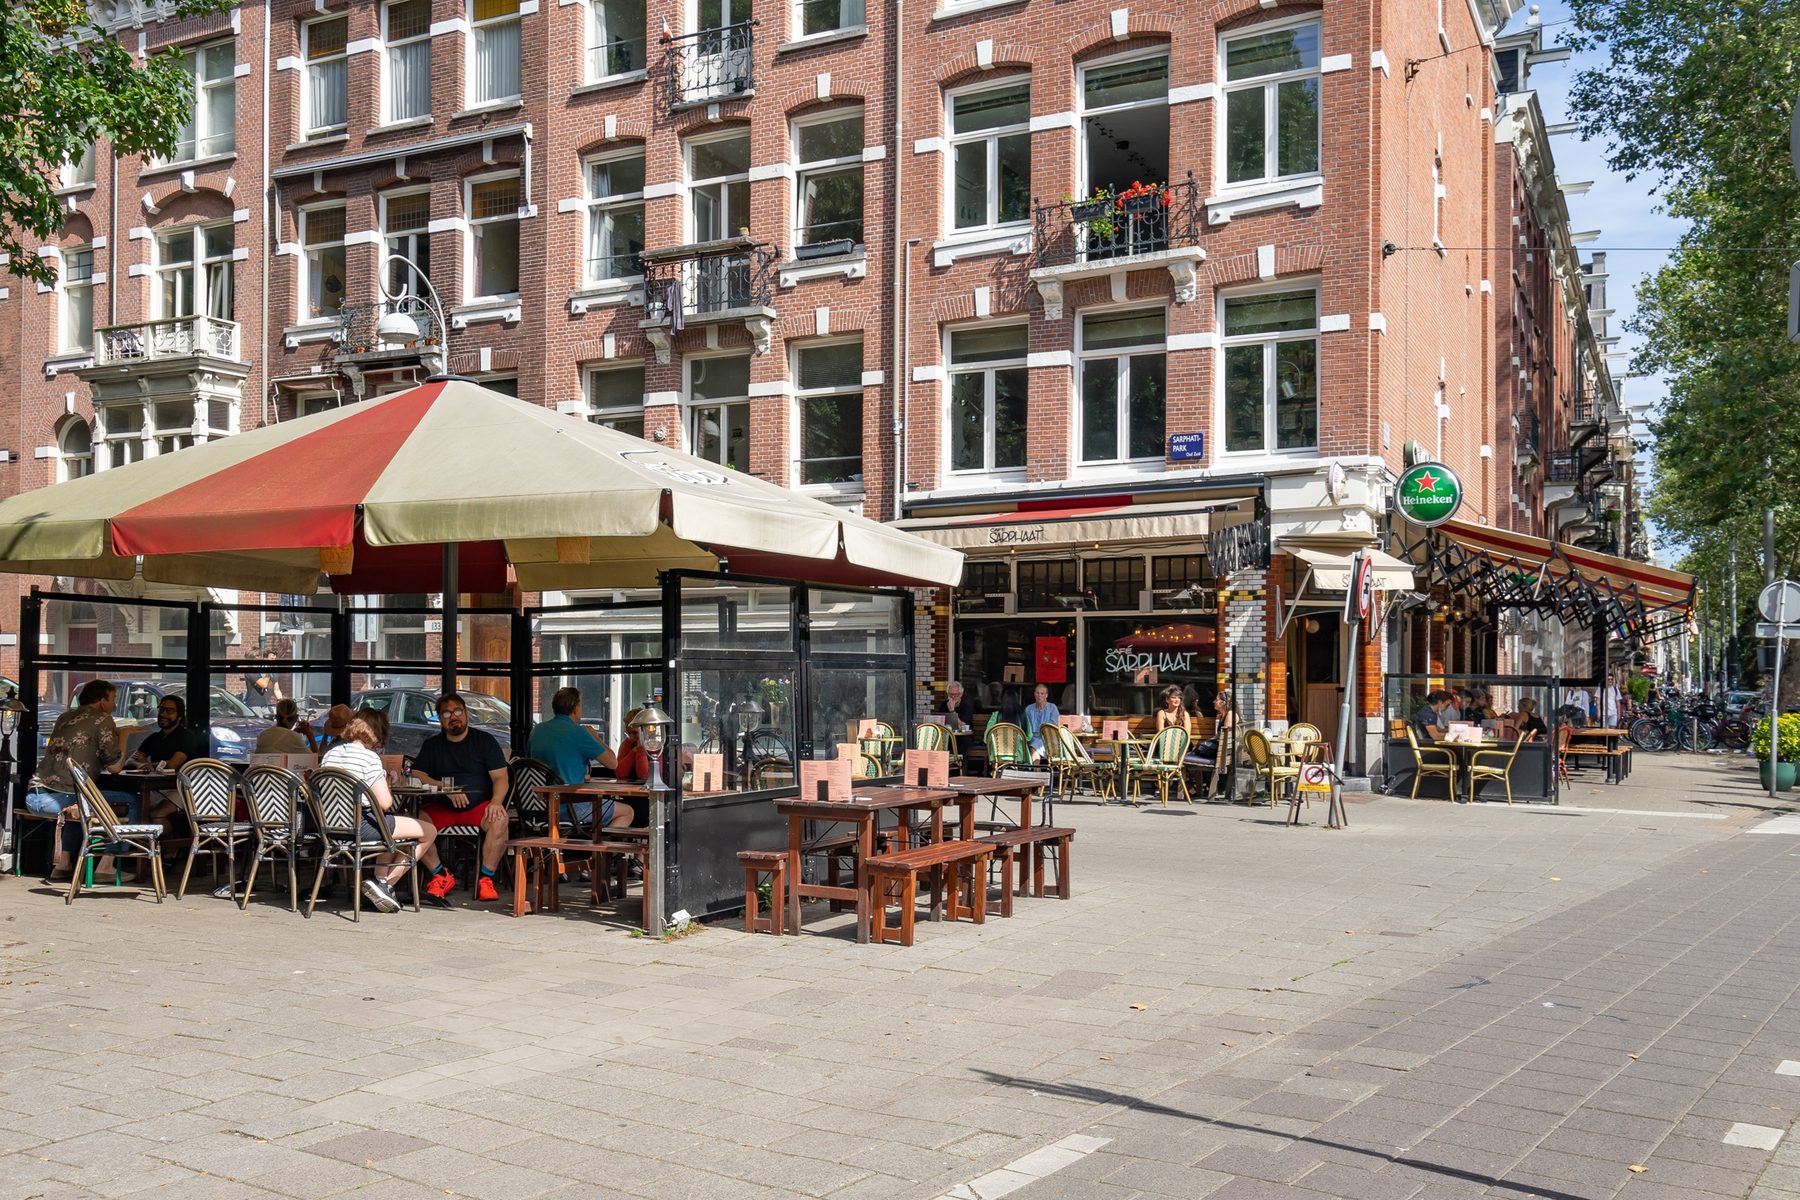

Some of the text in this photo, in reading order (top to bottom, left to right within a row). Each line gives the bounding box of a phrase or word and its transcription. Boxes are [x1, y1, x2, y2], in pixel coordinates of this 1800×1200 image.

[1172, 435, 1201, 443] SARPHATI-
[1172, 444, 1187, 452] PARK
[1403, 495, 1453, 505] Heineken
[989, 529, 1044, 544] SARPHAAT
[1106, 644, 1134, 655] CAFÉ
[1105, 651, 1198, 673] SARPHAAT
